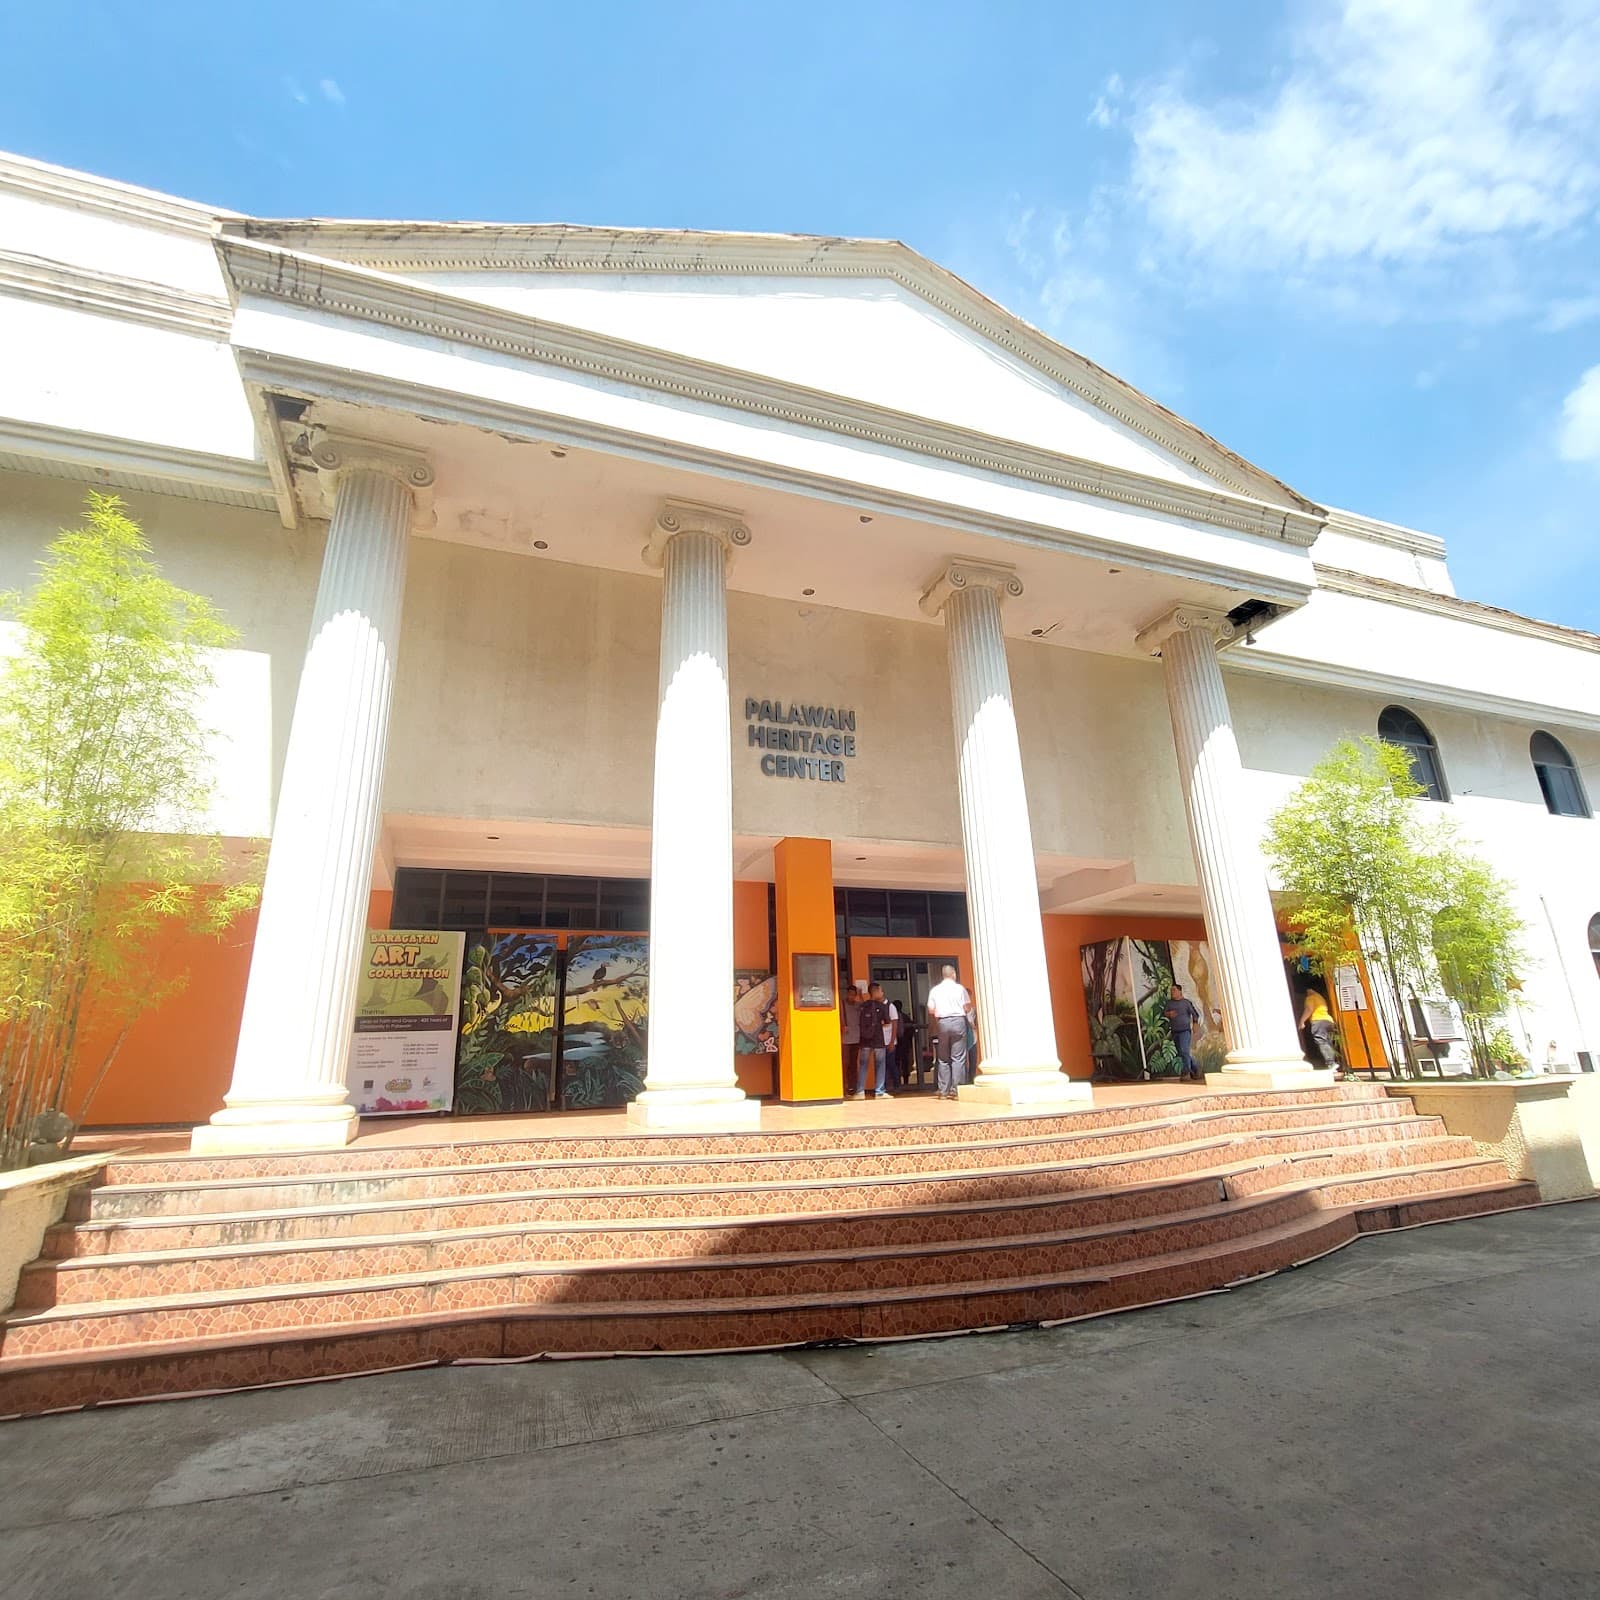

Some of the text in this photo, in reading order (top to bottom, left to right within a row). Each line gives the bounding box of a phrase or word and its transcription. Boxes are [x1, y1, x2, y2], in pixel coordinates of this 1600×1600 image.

[745, 698, 856, 731] PALAWAN
[748, 724, 856, 757] HERITAGE
[760, 754, 845, 782] CENTER
[370, 934, 439, 944] BARAGATAN
[371, 945, 420, 967] ART
[368, 968, 449, 979] COMPETITION
